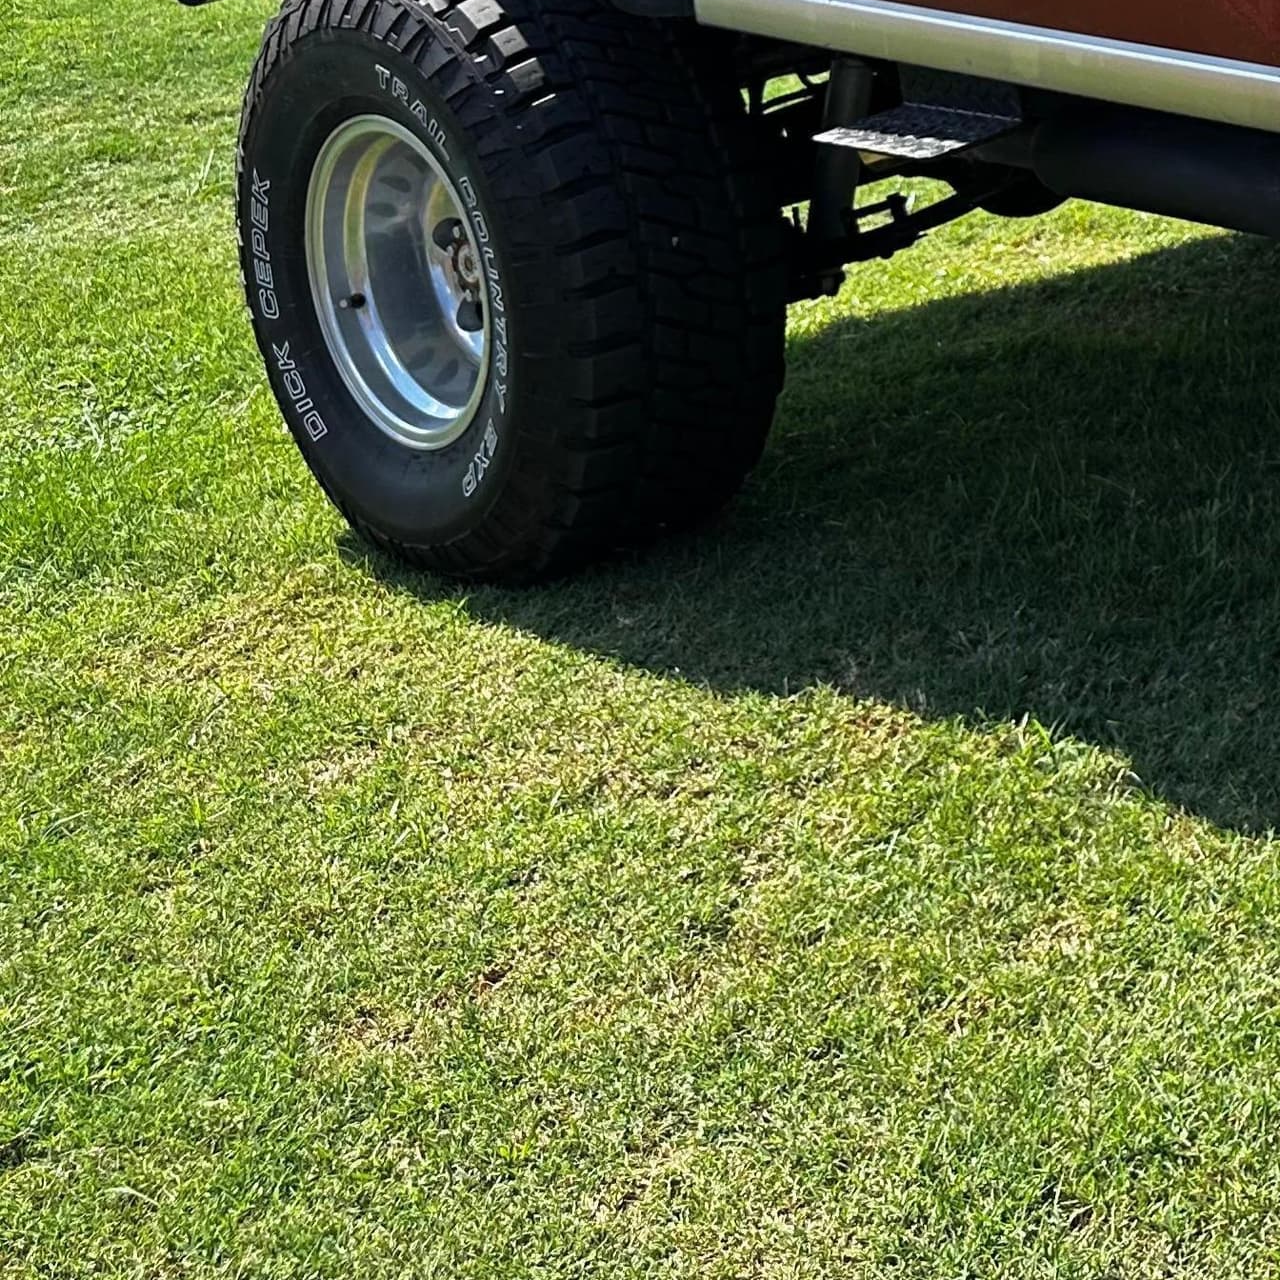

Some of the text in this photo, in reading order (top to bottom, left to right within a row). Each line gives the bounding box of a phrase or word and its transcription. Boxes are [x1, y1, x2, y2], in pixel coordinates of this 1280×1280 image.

[374, 63, 450, 161] TRAIL
[251, 167, 328, 442] DICK CEPEK
